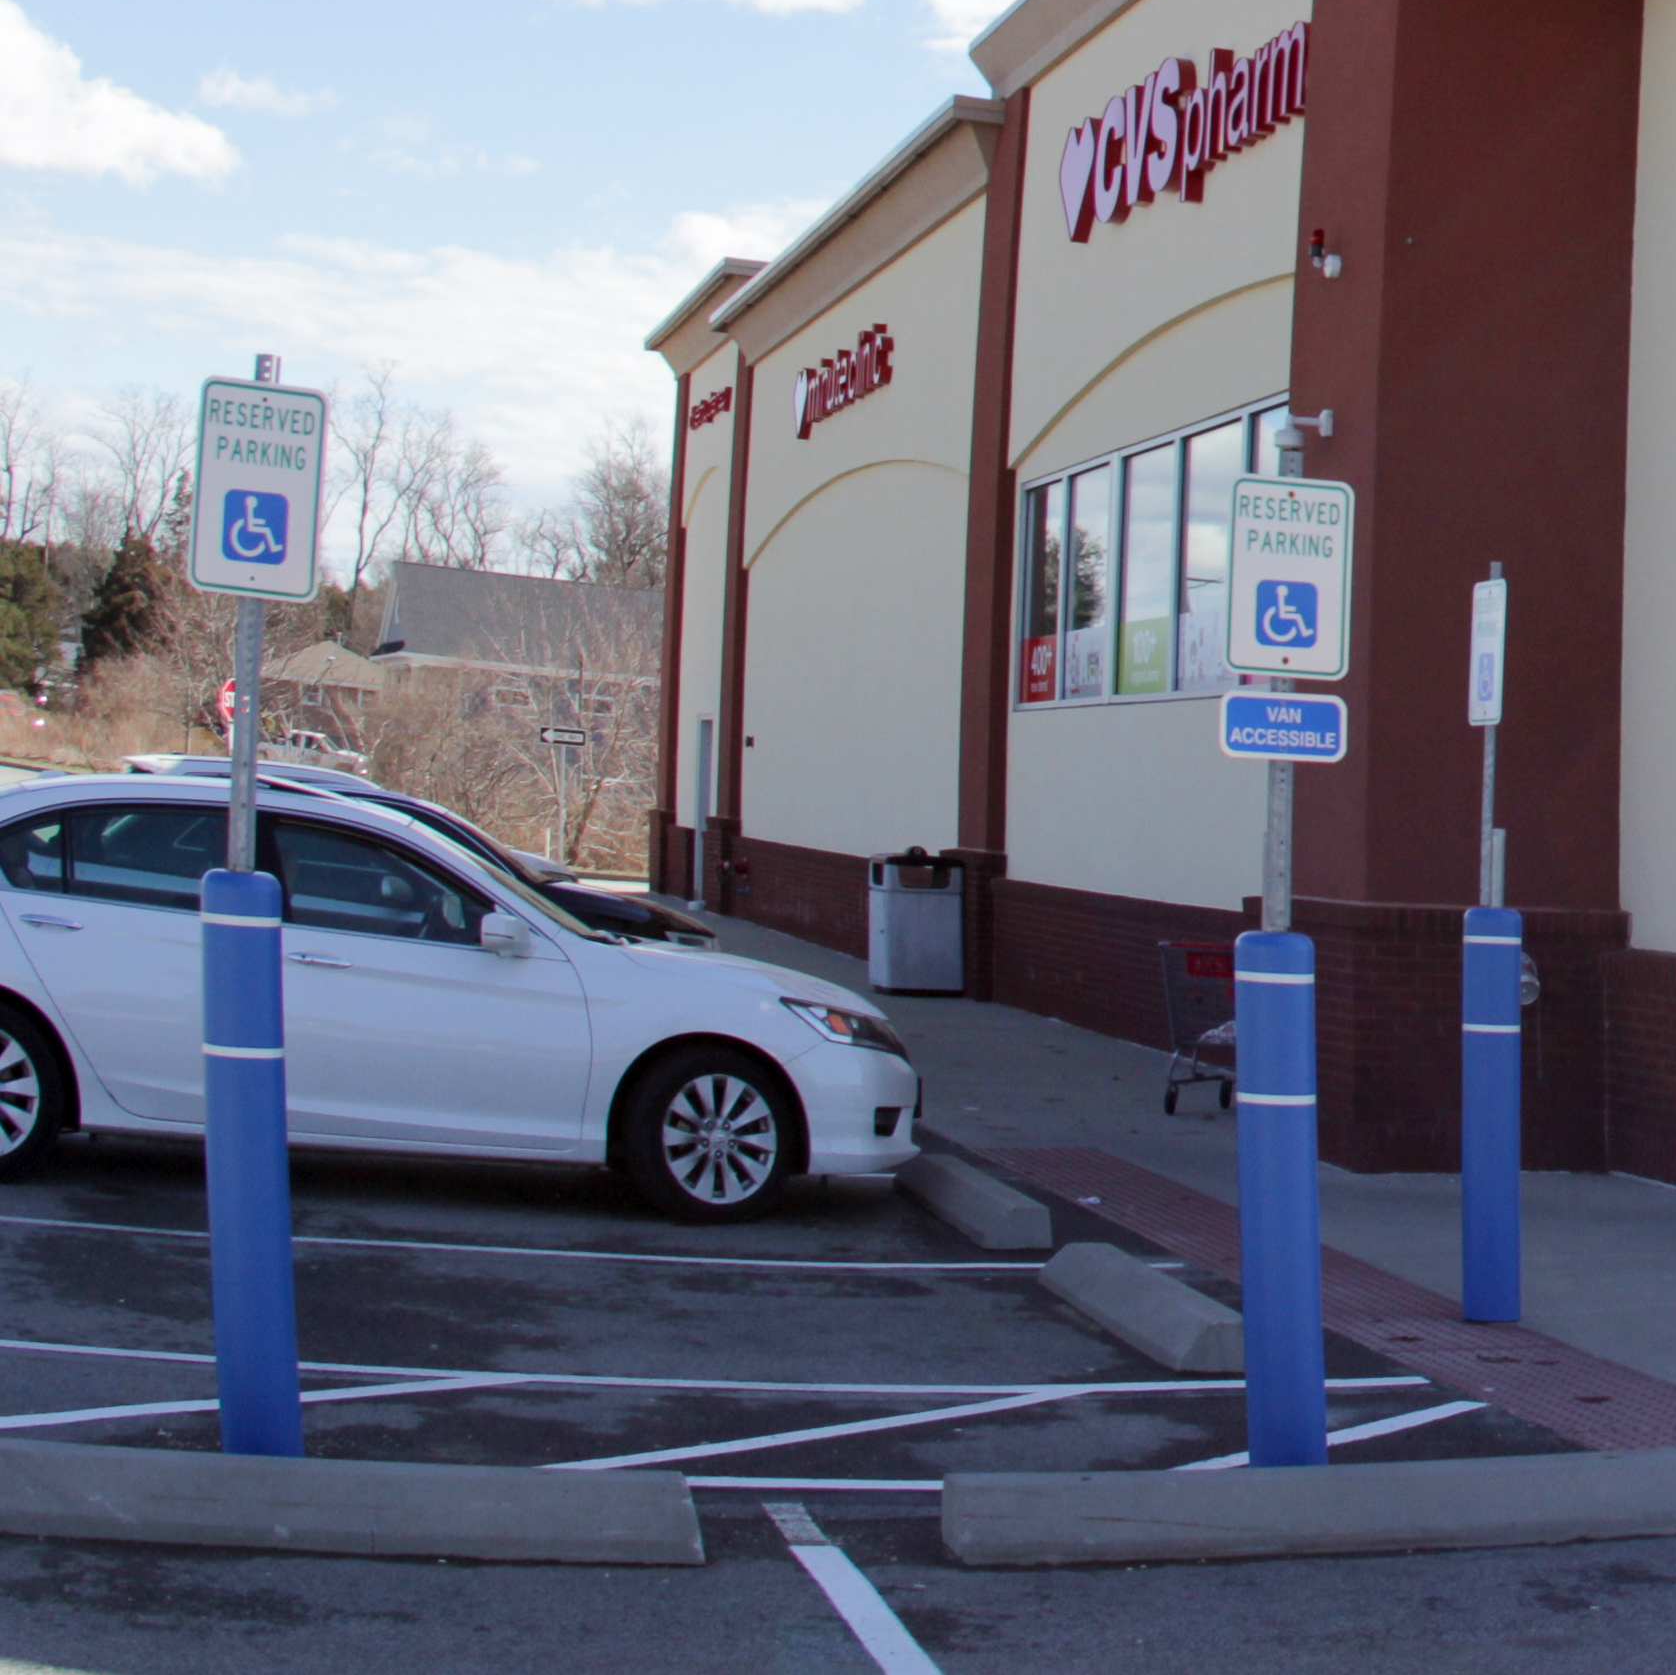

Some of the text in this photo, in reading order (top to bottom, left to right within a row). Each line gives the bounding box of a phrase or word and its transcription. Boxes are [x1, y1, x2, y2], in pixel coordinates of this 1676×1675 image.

[1095, 20, 1311, 224] CVS pharm
[208, 399, 315, 436] RESERVED
[216, 436, 306, 471] PARKING
[1239, 495, 1340, 526] RESERVED
[1247, 529, 1333, 558] PARKING
[1031, 645, 1053, 676] 400+
[1266, 706, 1301, 724] VAN
[1229, 728, 1336, 749] ACCESSIBLE
